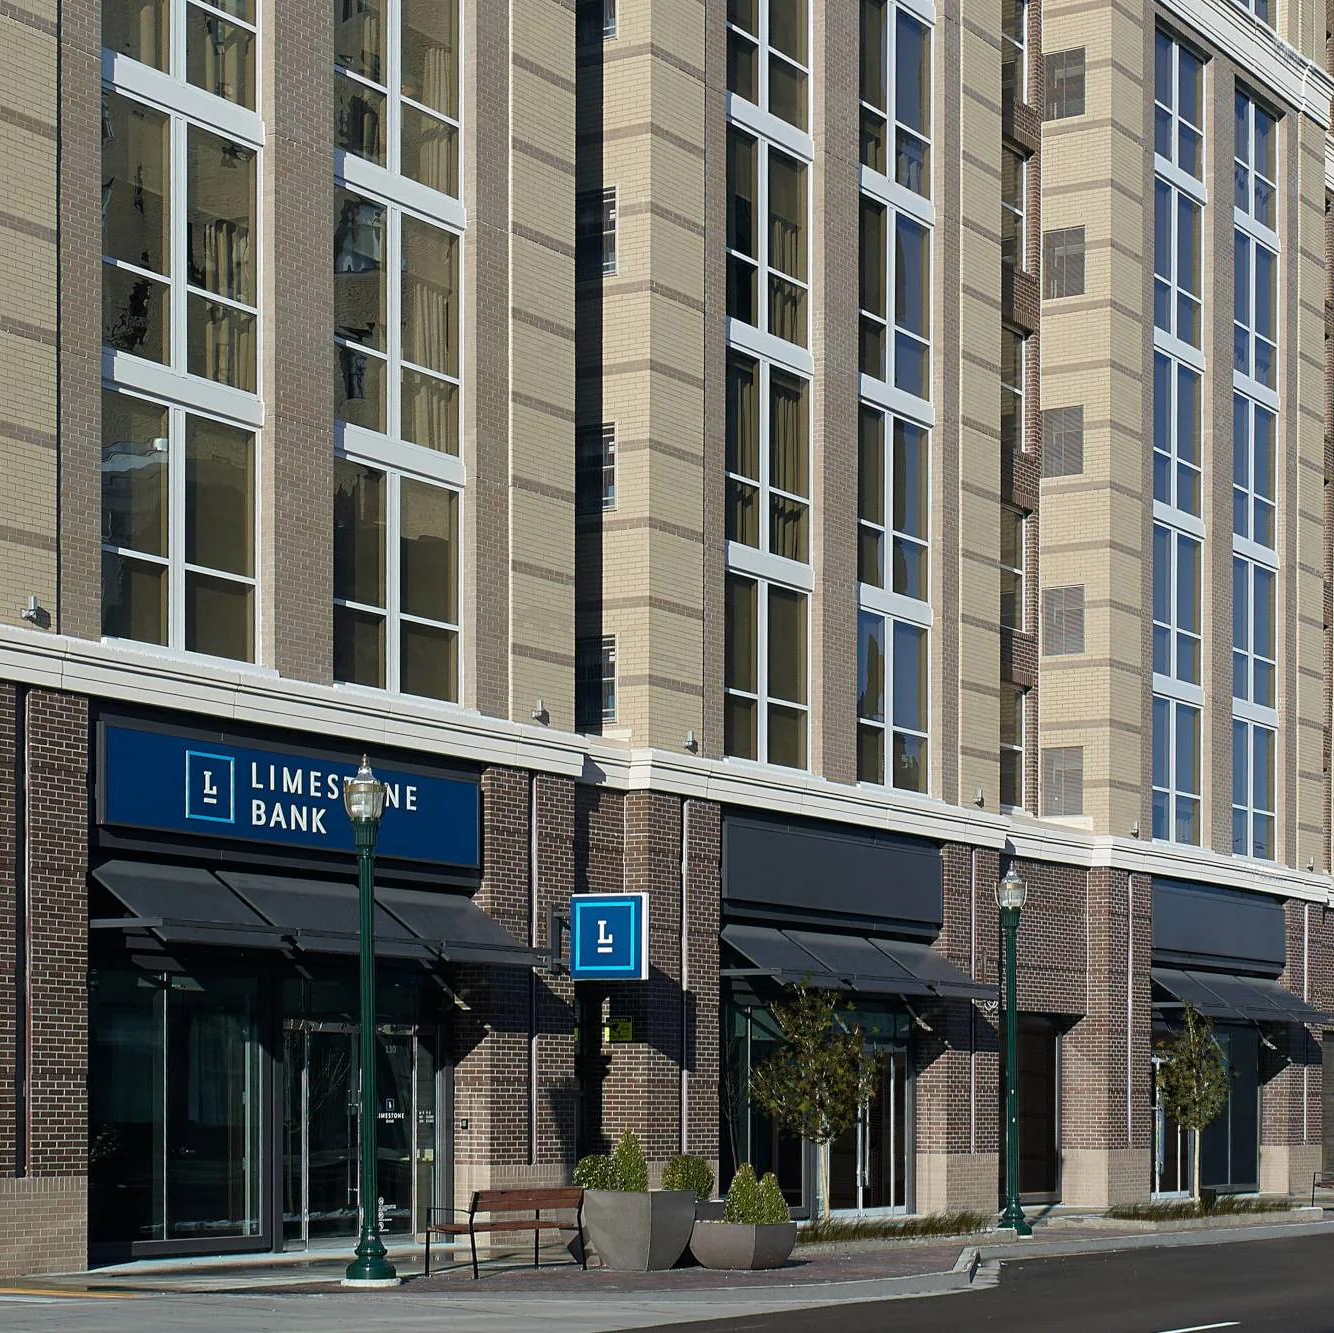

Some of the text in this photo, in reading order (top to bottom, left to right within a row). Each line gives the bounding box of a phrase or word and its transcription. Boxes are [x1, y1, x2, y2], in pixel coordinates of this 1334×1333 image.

[203, 770, 217, 795] L
[251, 761, 418, 811] LIMESNE
[251, 799, 327, 834] BANK
[597, 920, 613, 944] L
[385, 1045, 397, 1054] 130
